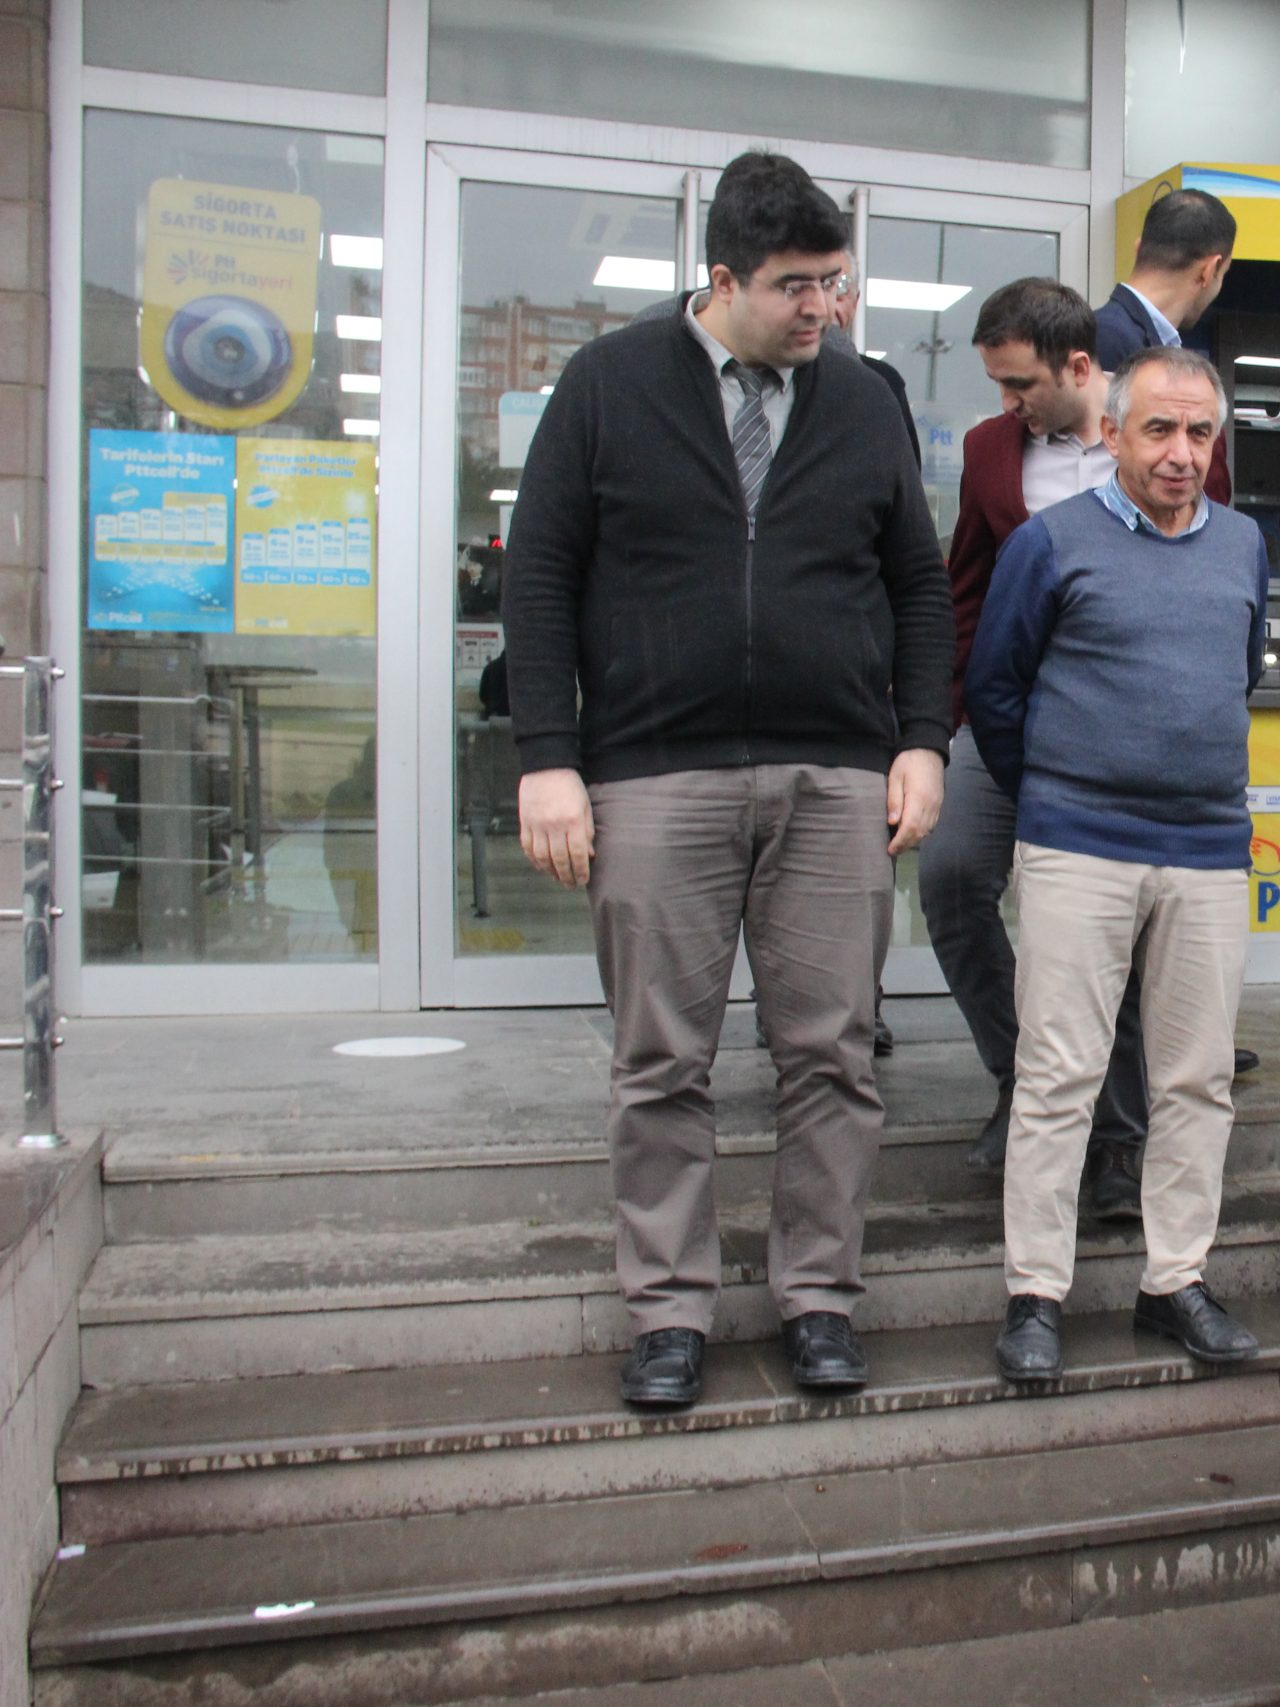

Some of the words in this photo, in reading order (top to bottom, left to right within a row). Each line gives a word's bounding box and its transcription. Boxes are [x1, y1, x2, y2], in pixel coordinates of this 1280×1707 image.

[193, 191, 277, 221] SİGORTA
[159, 211, 217, 235] SATIŞ
[223, 222, 305, 243] NOKTASI
[929, 427, 953, 448] Ptt
